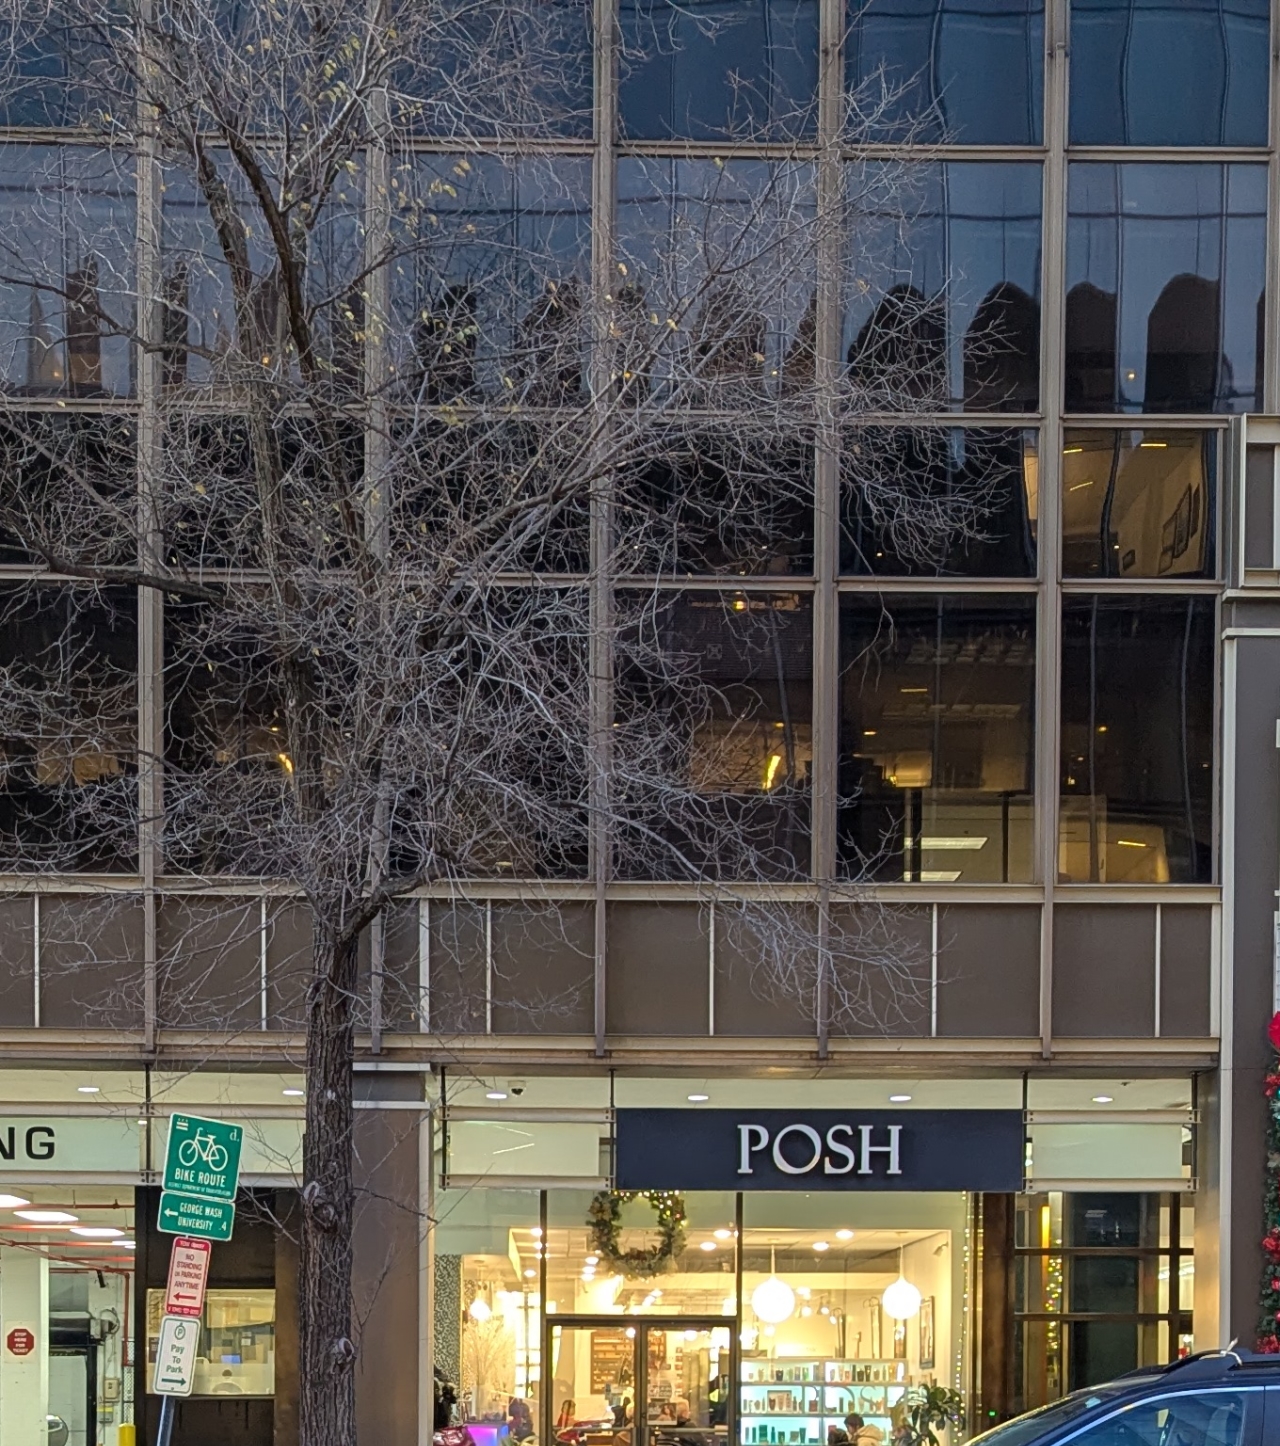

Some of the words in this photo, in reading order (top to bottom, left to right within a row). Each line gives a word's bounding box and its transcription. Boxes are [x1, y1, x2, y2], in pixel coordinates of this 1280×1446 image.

[736, 1123, 903, 1175] POSH
[174, 1168, 195, 1183] BIKE
[198, 1172, 227, 1188] ROUTE
[179, 1202, 204, 1216] GEORGE
[204, 1206, 223, 1219] WASH
[177, 1216, 214, 1231] UNIVERSITY
[185, 1253, 195, 1261] NO
[176, 1261, 202, 1271] STANDING
[181, 1271, 202, 1280] PARKING
[174, 1281, 200, 1290] ANYTIME
[170, 1343, 185, 1355] Pay
[172, 1355, 182, 1364] To
[165, 1364, 183, 1374] Park
